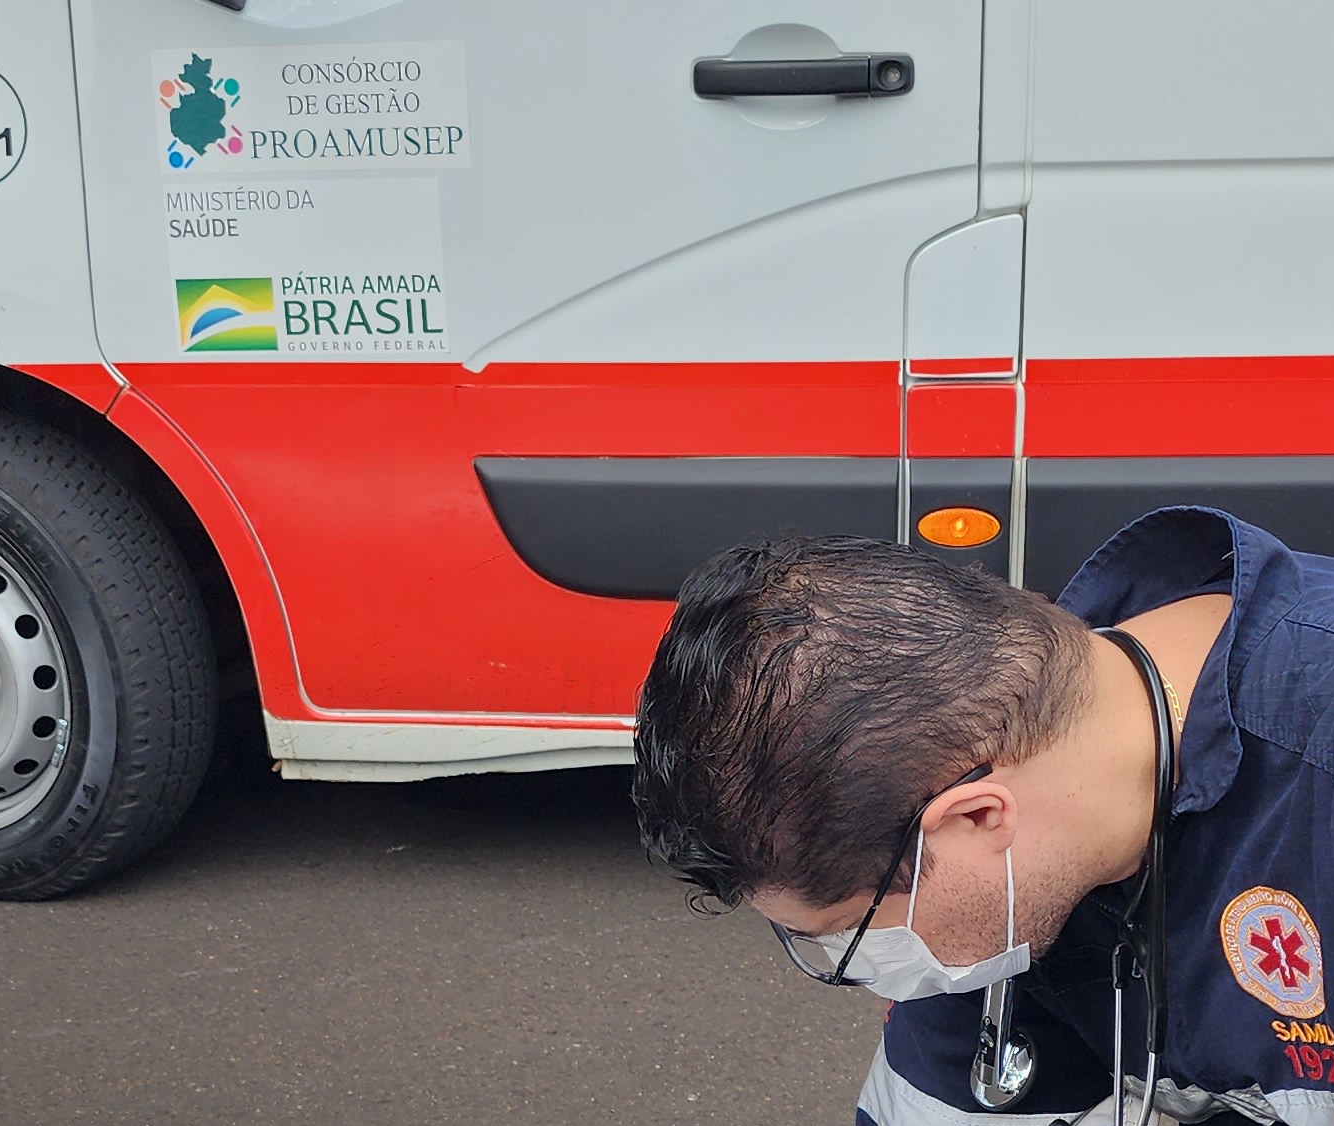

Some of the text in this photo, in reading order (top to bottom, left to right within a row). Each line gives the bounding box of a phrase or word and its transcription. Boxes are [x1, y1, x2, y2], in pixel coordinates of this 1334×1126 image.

[282, 56, 421, 85] CONSÓRCIO
[287, 87, 420, 116] DE GESTÃO
[250, 125, 464, 160] PROAMUSEP
[167, 186, 315, 213] MINISTÉRIO DA
[170, 214, 240, 238] SAÚDE
[282, 270, 442, 296] PÁTRIA AMADA
[284, 299, 444, 336] BRASIL
[287, 340, 446, 352] GOVERNO FEDERAL
